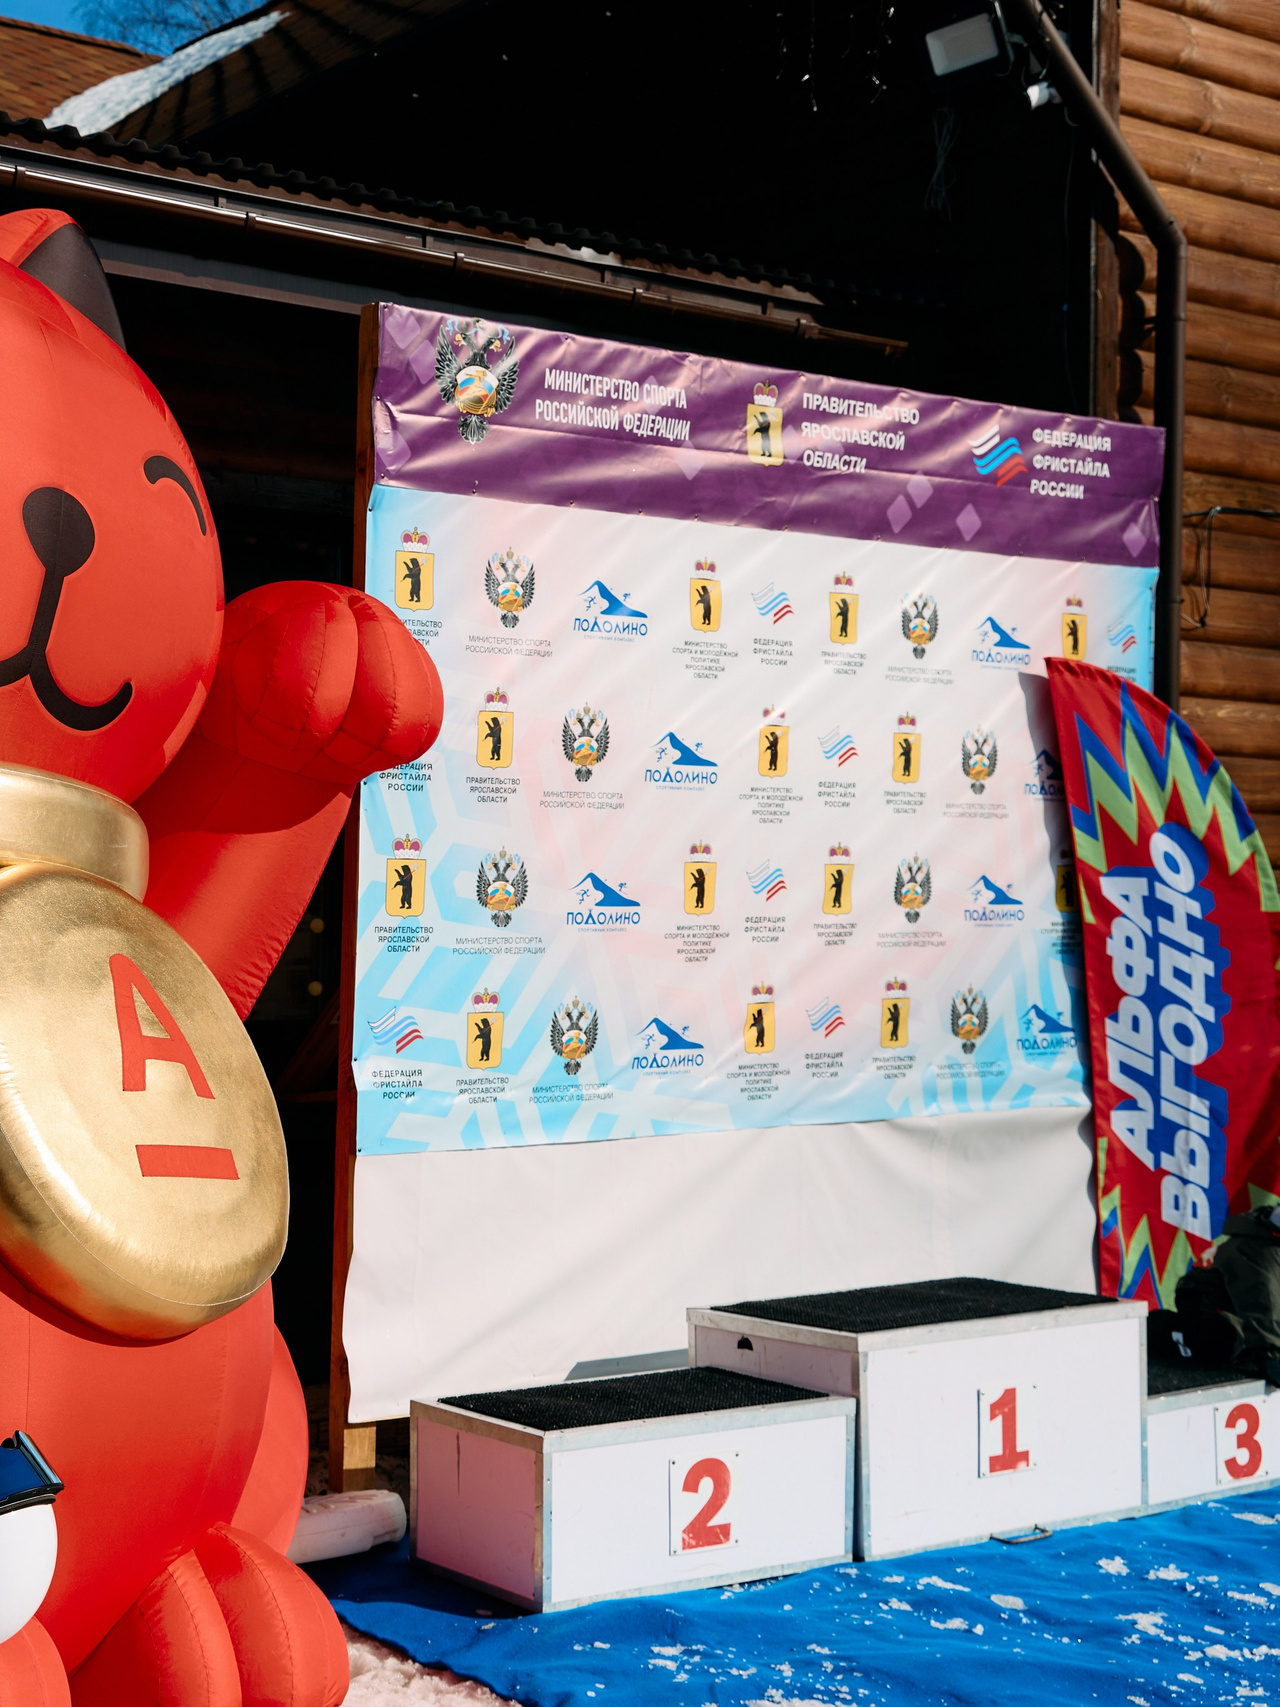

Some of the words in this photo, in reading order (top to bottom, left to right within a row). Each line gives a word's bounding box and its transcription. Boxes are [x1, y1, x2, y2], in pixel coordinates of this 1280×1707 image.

[544, 367, 640, 402] МИНИСТЕРСТВО
[643, 383, 688, 409] СПОРТА
[802, 392, 920, 425] ПРАВИТЕЛЬСТВО
[535, 398, 620, 431] РОССИЙСКОЙ
[622, 411, 691, 441] ФЕДЕРАЦИИ
[800, 421, 906, 451] ЯРОСЛАВСКОЙ
[1032, 427, 1112, 453] ФЕДЕРАЦИЯ
[802, 449, 867, 474] ОБЛАСТИ
[1032, 453, 1111, 478] ФРИСТАЙЛА
[1029, 478, 1085, 500] РОССИИ
[468, 635, 523, 647] МИНИСТЕРСТВО
[525, 638, 552, 647] СПОРТА
[752, 638, 793, 647] ФЕДЕРАЦИЯ
[464, 644, 513, 655] РОССИЙСКОЙ
[514, 648, 554, 659] ФЕДЕРАЦИИ
[752, 647, 793, 657] ФРИСТАЙЛА
[760, 658, 788, 666] РОССИИ
[379, 771, 432, 782] ФРИСТАЙЛА
[465, 776, 521, 786] ПРАВИТЕЛЬСТВО
[387, 783, 424, 792] РОССИИ
[750, 786, 793, 794] МИНИСТЕРСТВО
[818, 781, 856, 789] ФЕДЕРАЦИЯ
[469, 786, 517, 795] ЯРОСЛАВСКОЙ
[543, 790, 597, 799] МИНИСТЕРСТВО
[597, 791, 623, 800] СПОРТА
[817, 790, 856, 798] ФРИСТАЙЛА
[477, 795, 508, 803] ОБЛАСТИ
[824, 800, 850, 808] РОССИИ
[539, 799, 586, 808] РОССИЙСКОЙ
[586, 800, 625, 810] ФЕДЕРАЦИИ
[751, 809, 790, 817] ЯРОСЛАВСКОЙ
[744, 916, 786, 924] ФЕДЕРАЦИЯ
[374, 926, 434, 934] ПРАВИТЕЛЬСТВО
[744, 925, 785, 933] ФРИСТАЙЛА
[377, 935, 430, 943] ЯРОСЛАВСКОЙ
[455, 937, 513, 945] МИНИСТЕРСТВО
[514, 936, 543, 944] СПОРТА
[387, 945, 421, 953] ОБЛАСТИ
[452, 946, 502, 955] РОССИЙСКОЙ
[503, 946, 546, 955] ФЕДЕРАЦИИ
[1099, 875, 1155, 1172] АЛЬФА
[1149, 830, 1216, 1242] ВЫГОДНО
[805, 1051, 843, 1060] ФЕДЕРАЦИЯ
[805, 1060, 844, 1069] ФРИСТАЙЛА
[371, 1068, 423, 1078] ФЕДЕРАЦИЯ
[372, 1078, 423, 1089] ФРИСТАЙЛА
[455, 1076, 510, 1086] ПРАВИТЕЛЬСТВО
[458, 1085, 506, 1096] ЯРОСЛАВСКОЙ
[532, 1084, 583, 1094] МИНИСТЕРСТВО
[382, 1090, 416, 1100] РОССИИ
[468, 1096, 498, 1104] ОБЛАСТИ
[528, 1094, 575, 1104] РОССИЙСКОЙ
[575, 1092, 614, 1102] ФЕДЕРАЦИИ
[987, 1387, 1031, 1474] 1
[1223, 1402, 1264, 1481] 3
[681, 1457, 732, 1552] 2
